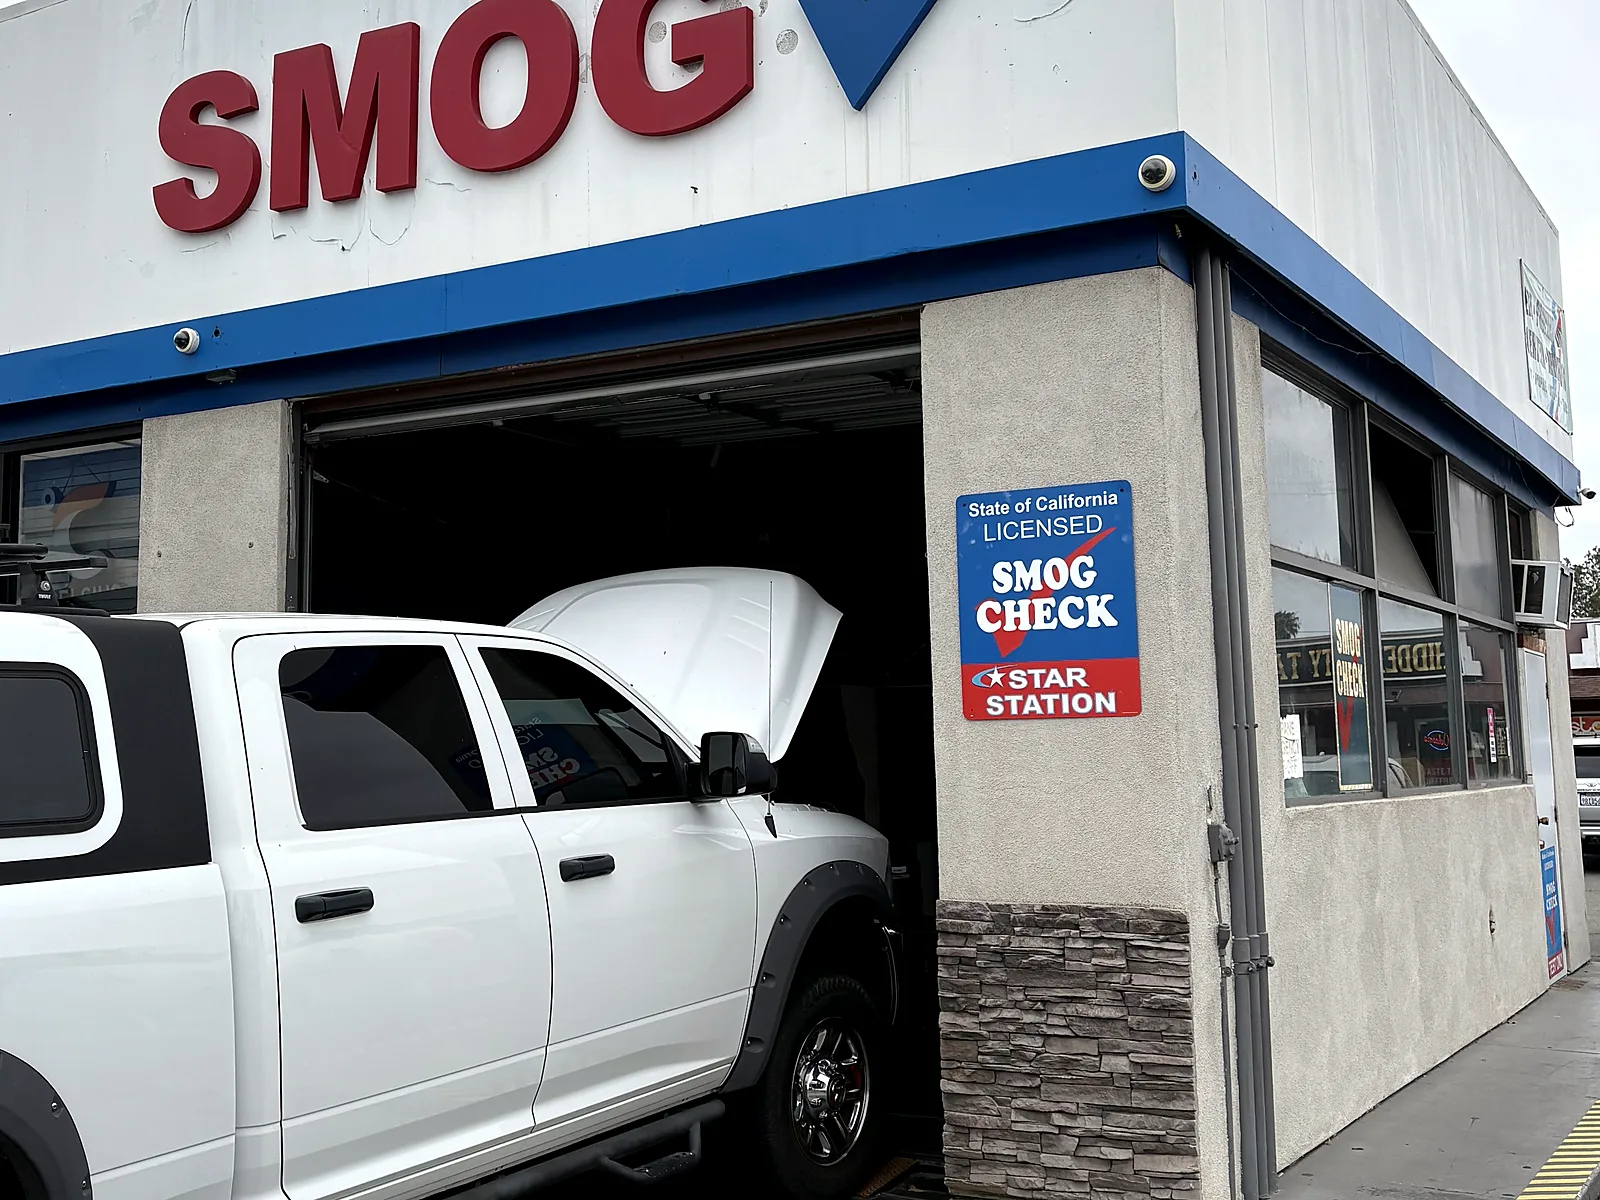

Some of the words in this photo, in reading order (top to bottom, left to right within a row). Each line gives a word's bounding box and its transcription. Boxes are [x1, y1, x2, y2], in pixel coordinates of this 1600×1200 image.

[152, 0, 755, 233] SMOG
[968, 502, 1010, 518] State
[1014, 498, 1032, 514] of
[1035, 490, 1118, 511] California
[983, 514, 1103, 542] LICENSED
[992, 555, 1097, 594] SMOG
[976, 594, 1118, 633] CHECK
[1335, 618, 1361, 659] SMOG
[1008, 667, 1089, 690] STAR
[1336, 659, 1365, 699] CHECK
[986, 691, 1116, 716] STATION
